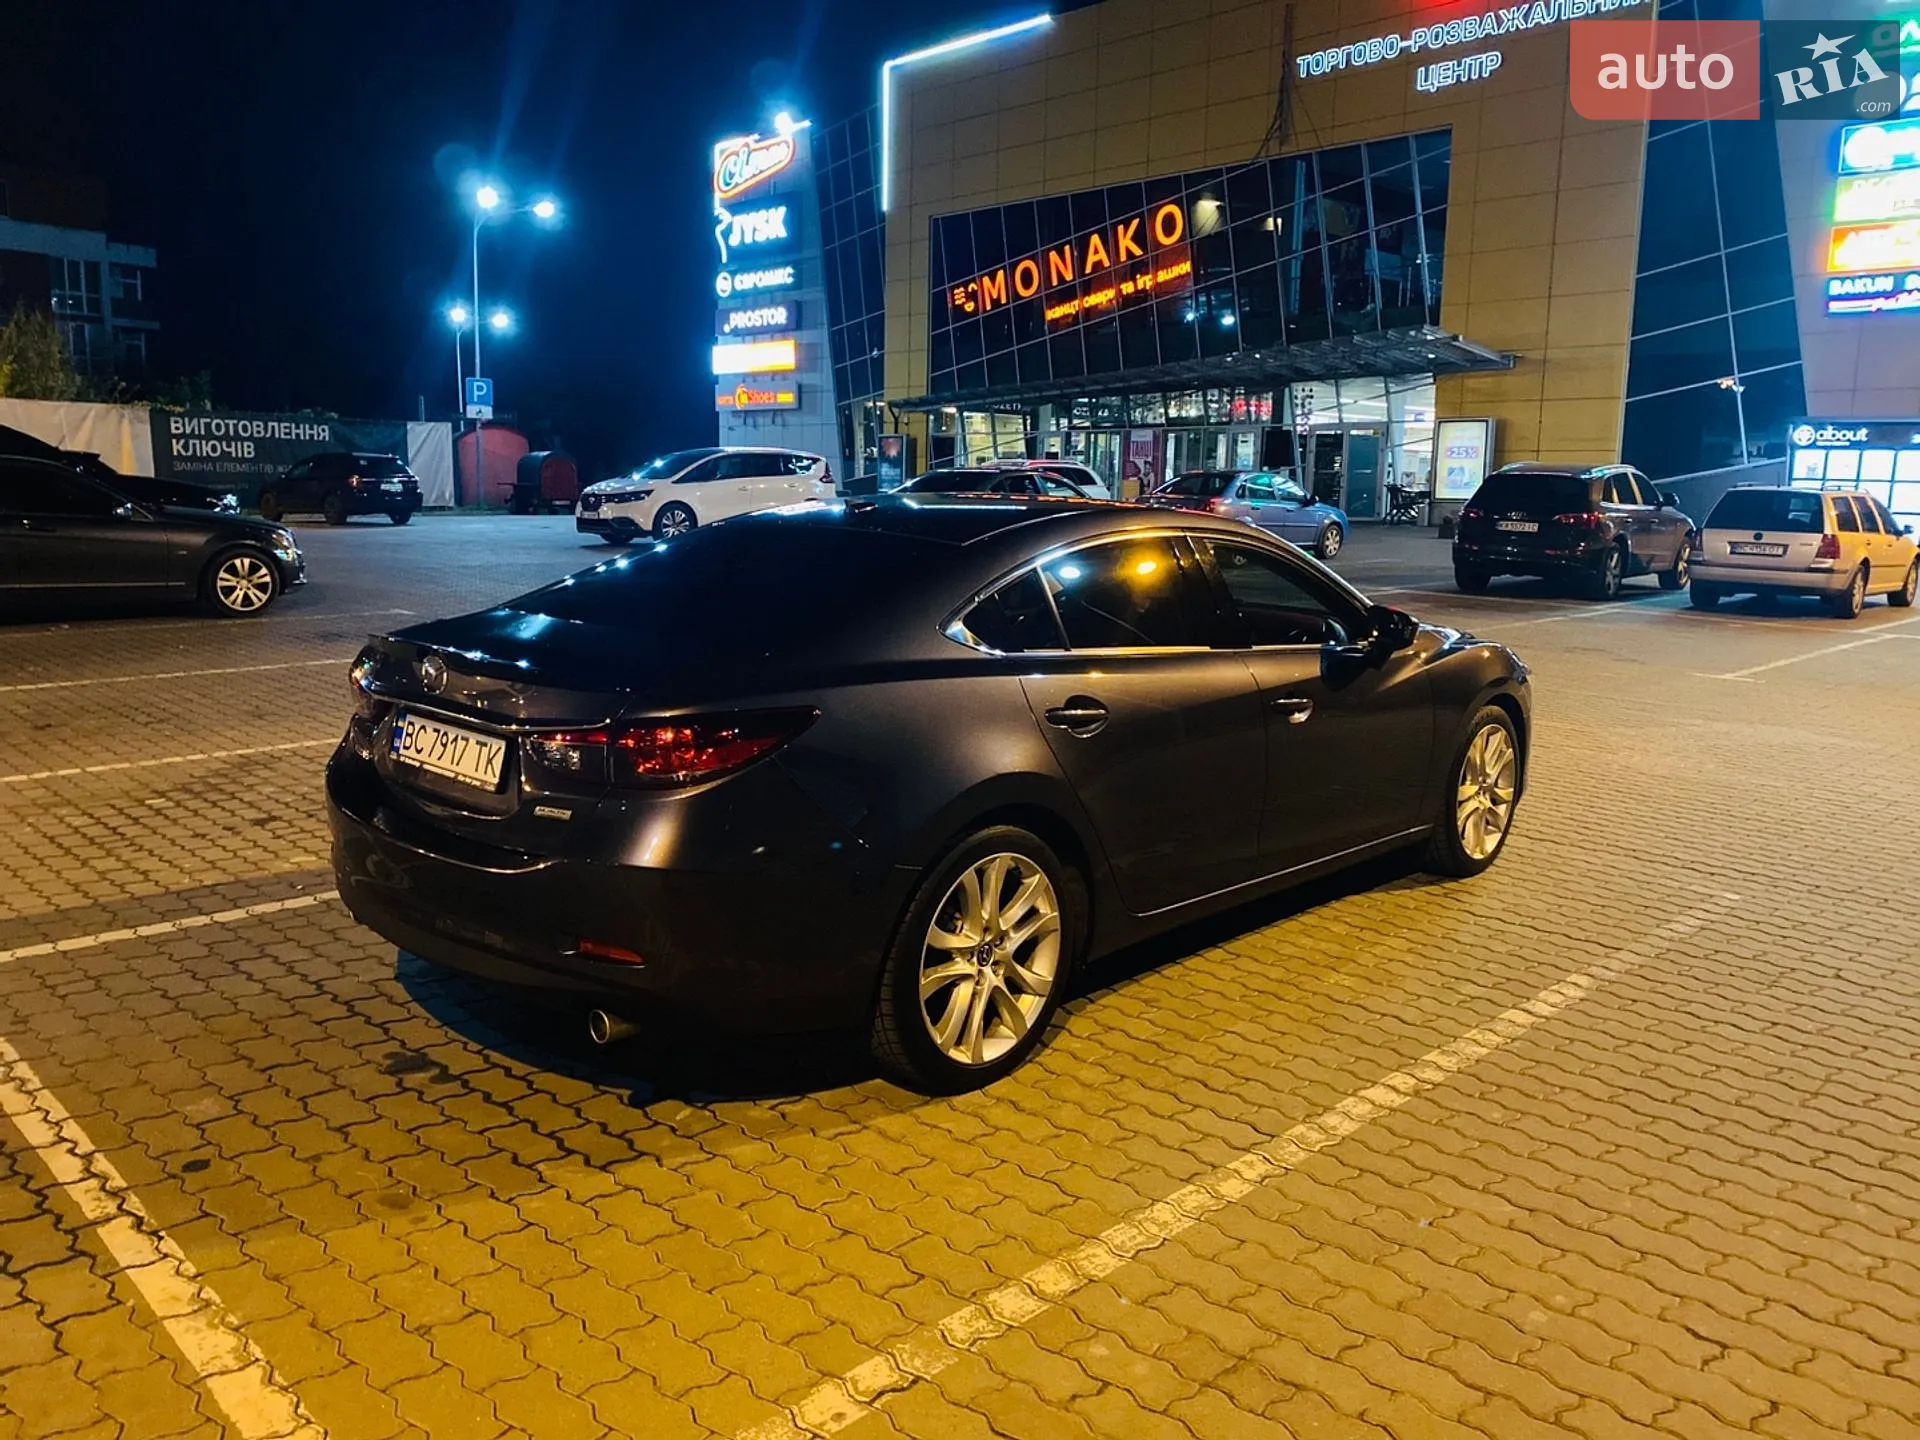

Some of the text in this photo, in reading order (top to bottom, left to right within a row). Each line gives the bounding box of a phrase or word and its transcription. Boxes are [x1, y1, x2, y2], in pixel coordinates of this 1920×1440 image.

[1297, 0, 1651, 78] ТОРГОВО-РОЗВАЖАЛЬН
[1416, 51, 1501, 92] ЦЕНТР
[728, 206, 787, 246] JYSK
[982, 203, 1184, 311] MONAKO
[729, 306, 787, 329] PROSTOR
[474, 382, 487, 402] P
[170, 416, 330, 442] ВИГОТОВЛЕННЯ
[1816, 426, 1868, 441] about
[172, 438, 256, 459] КЛЮЧІВ
[173, 461, 214, 472] ЗАМІНА
[403, 720, 427, 754] BC
[428, 728, 469, 766] 7917
[475, 740, 501, 778] TK
